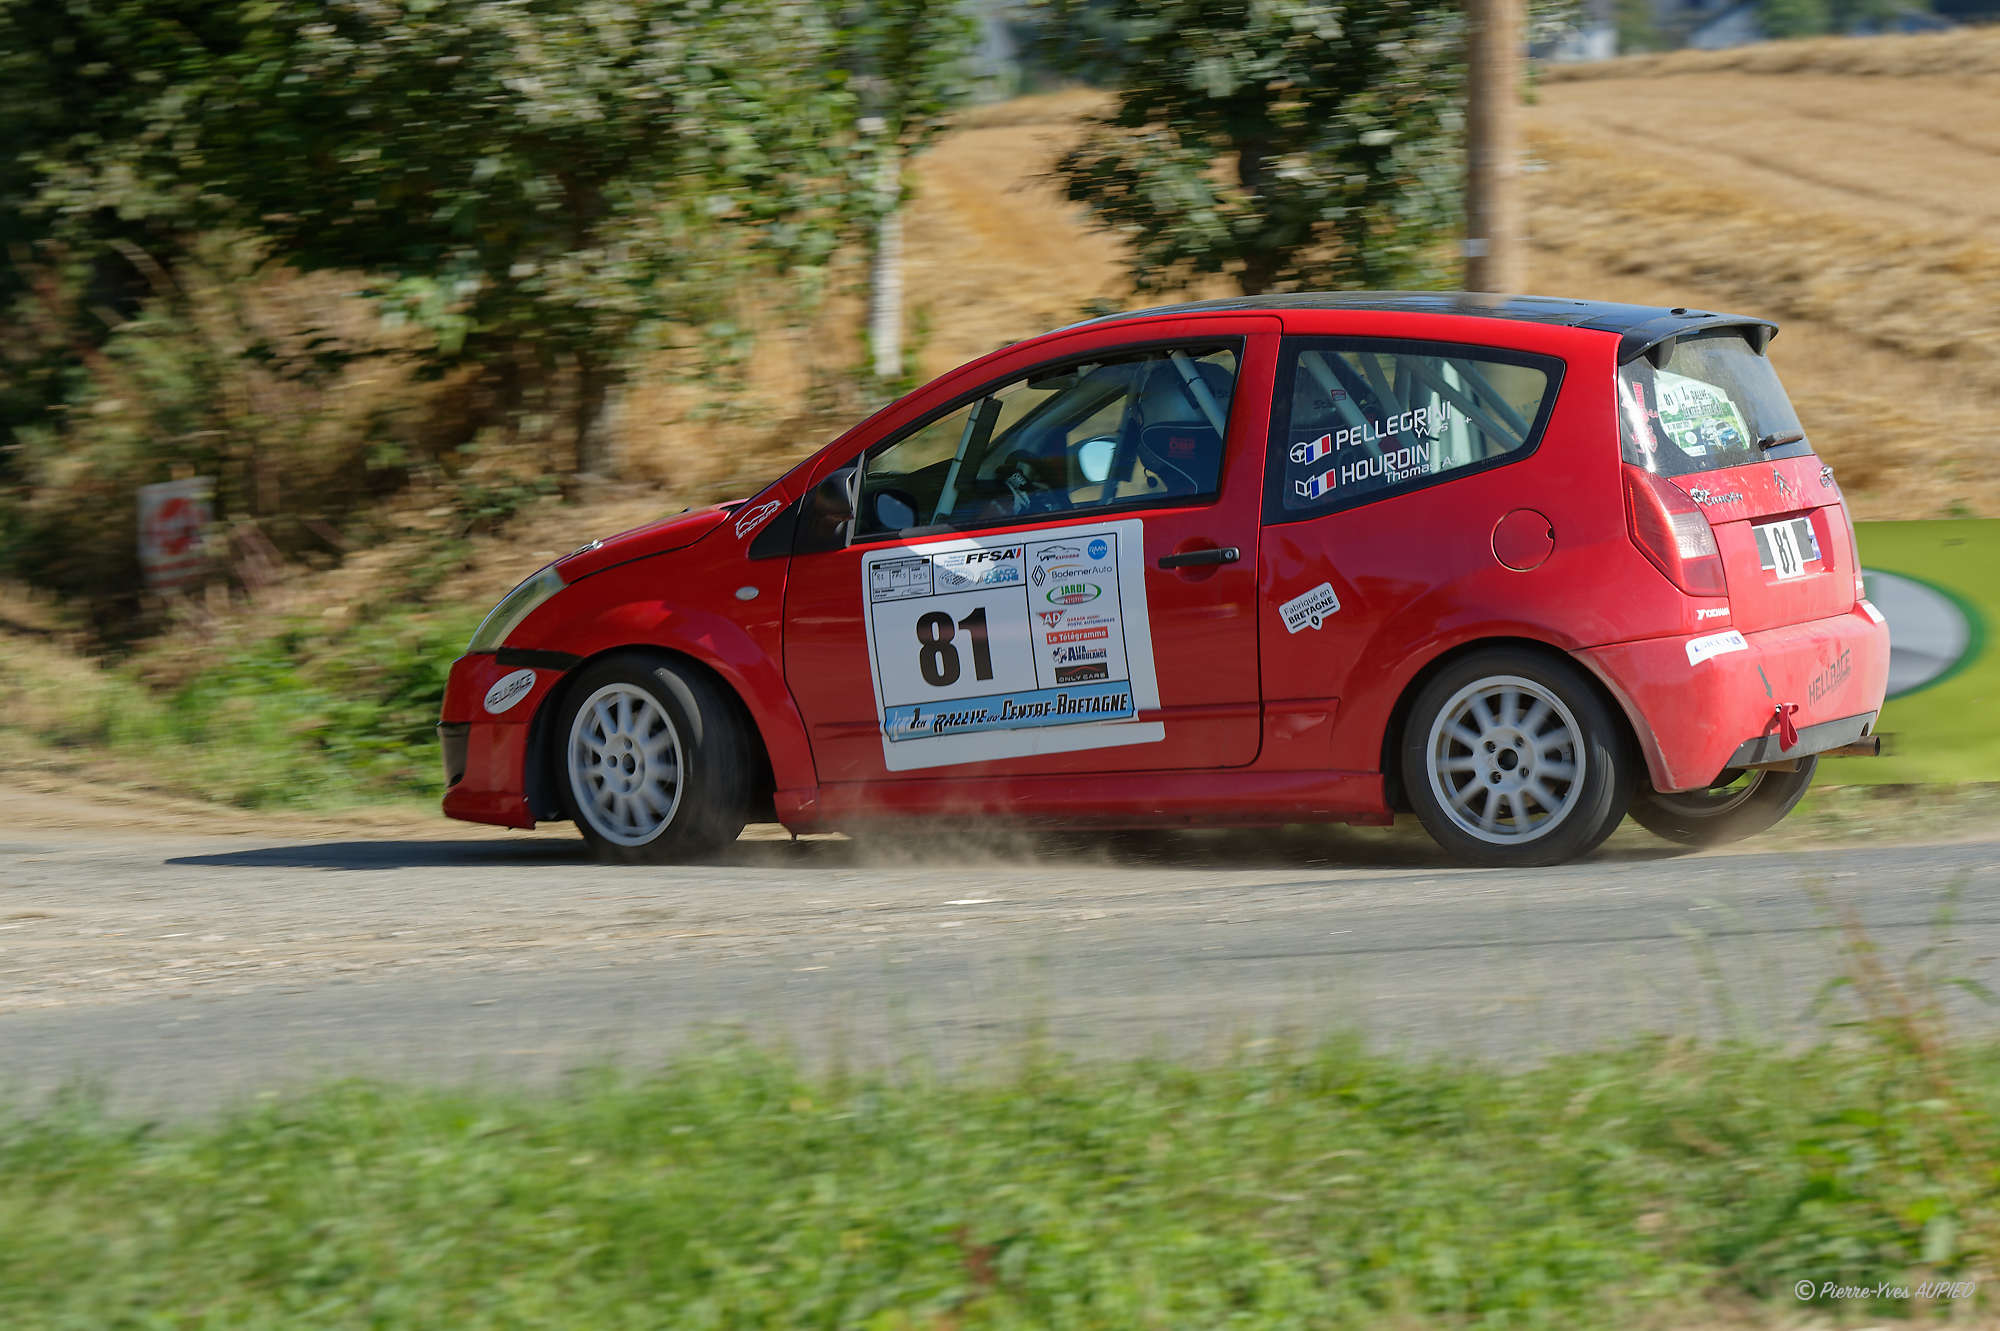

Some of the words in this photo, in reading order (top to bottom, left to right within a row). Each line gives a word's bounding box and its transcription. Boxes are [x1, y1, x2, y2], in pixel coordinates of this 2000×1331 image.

[1341, 442, 1430, 485] HOURDIN
[965, 549, 1015, 565] FFSA
[1773, 527, 1797, 574] 81
[1042, 611, 1061, 625] AD
[1288, 596, 1334, 624] BRETAGNE
[916, 607, 993, 687] 81
[1048, 635, 1057, 643] Le
[1060, 630, 1106, 641] Télégramme
